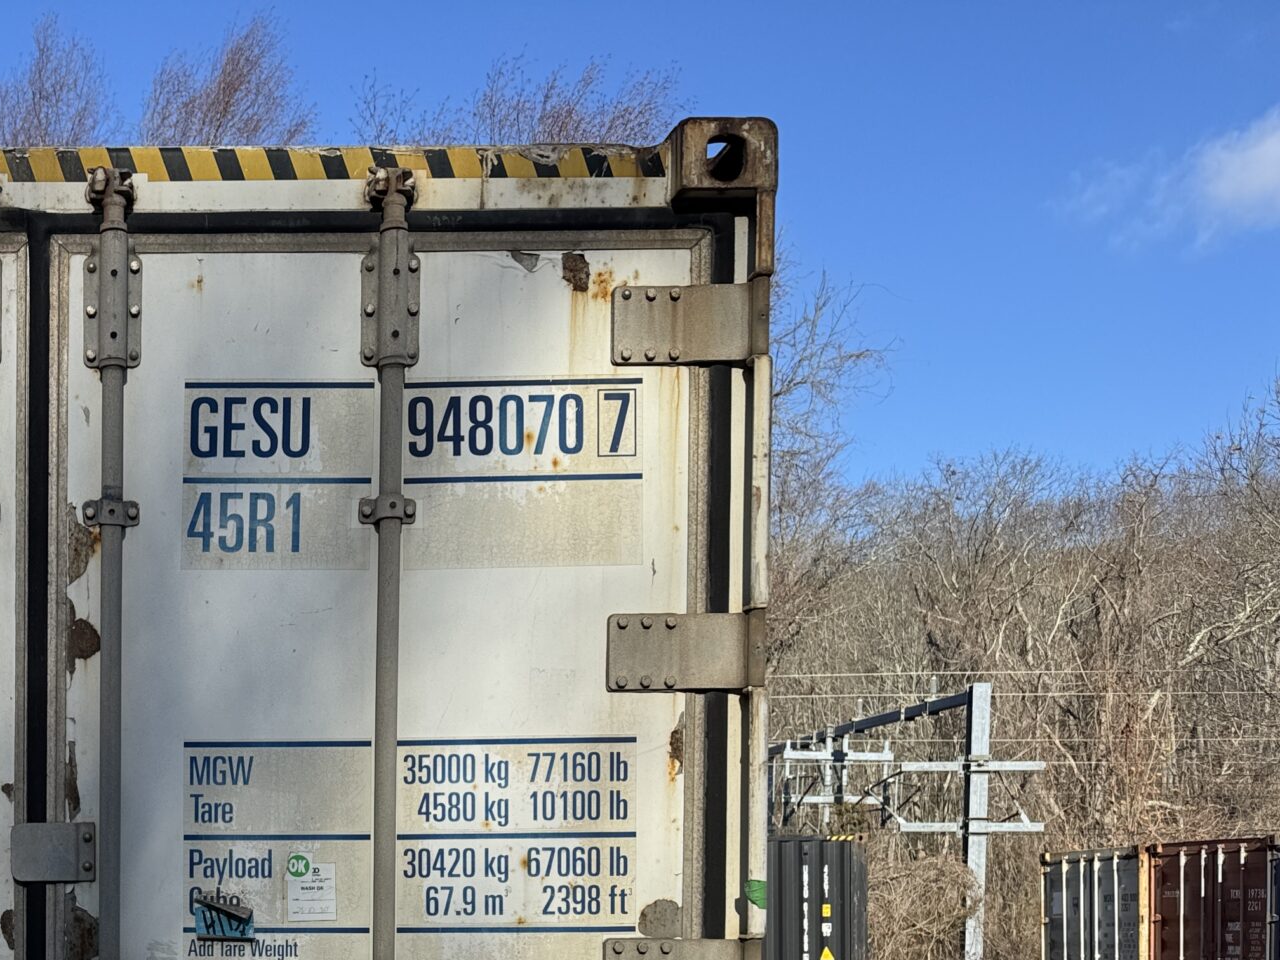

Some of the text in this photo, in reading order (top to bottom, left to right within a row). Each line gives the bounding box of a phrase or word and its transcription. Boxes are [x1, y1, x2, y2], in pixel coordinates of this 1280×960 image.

[189, 392, 631, 459] GESU 948070 7
[186, 491, 302, 554] 45R1
[189, 755, 254, 786] MGW
[403, 751, 629, 789] 35000 kg 77160 lb
[190, 793, 234, 825] Tare
[417, 790, 629, 827] 4580 kg 10100 lb
[189, 849, 272, 886] Payload
[288, 859, 307, 873] OK
[403, 847, 629, 883] 30420 kg 67060 lb
[425, 886, 476, 916] 67.9
[541, 884, 601, 915] 2398
[188, 939, 214, 957] Add
[250, 939, 298, 960] Weight
